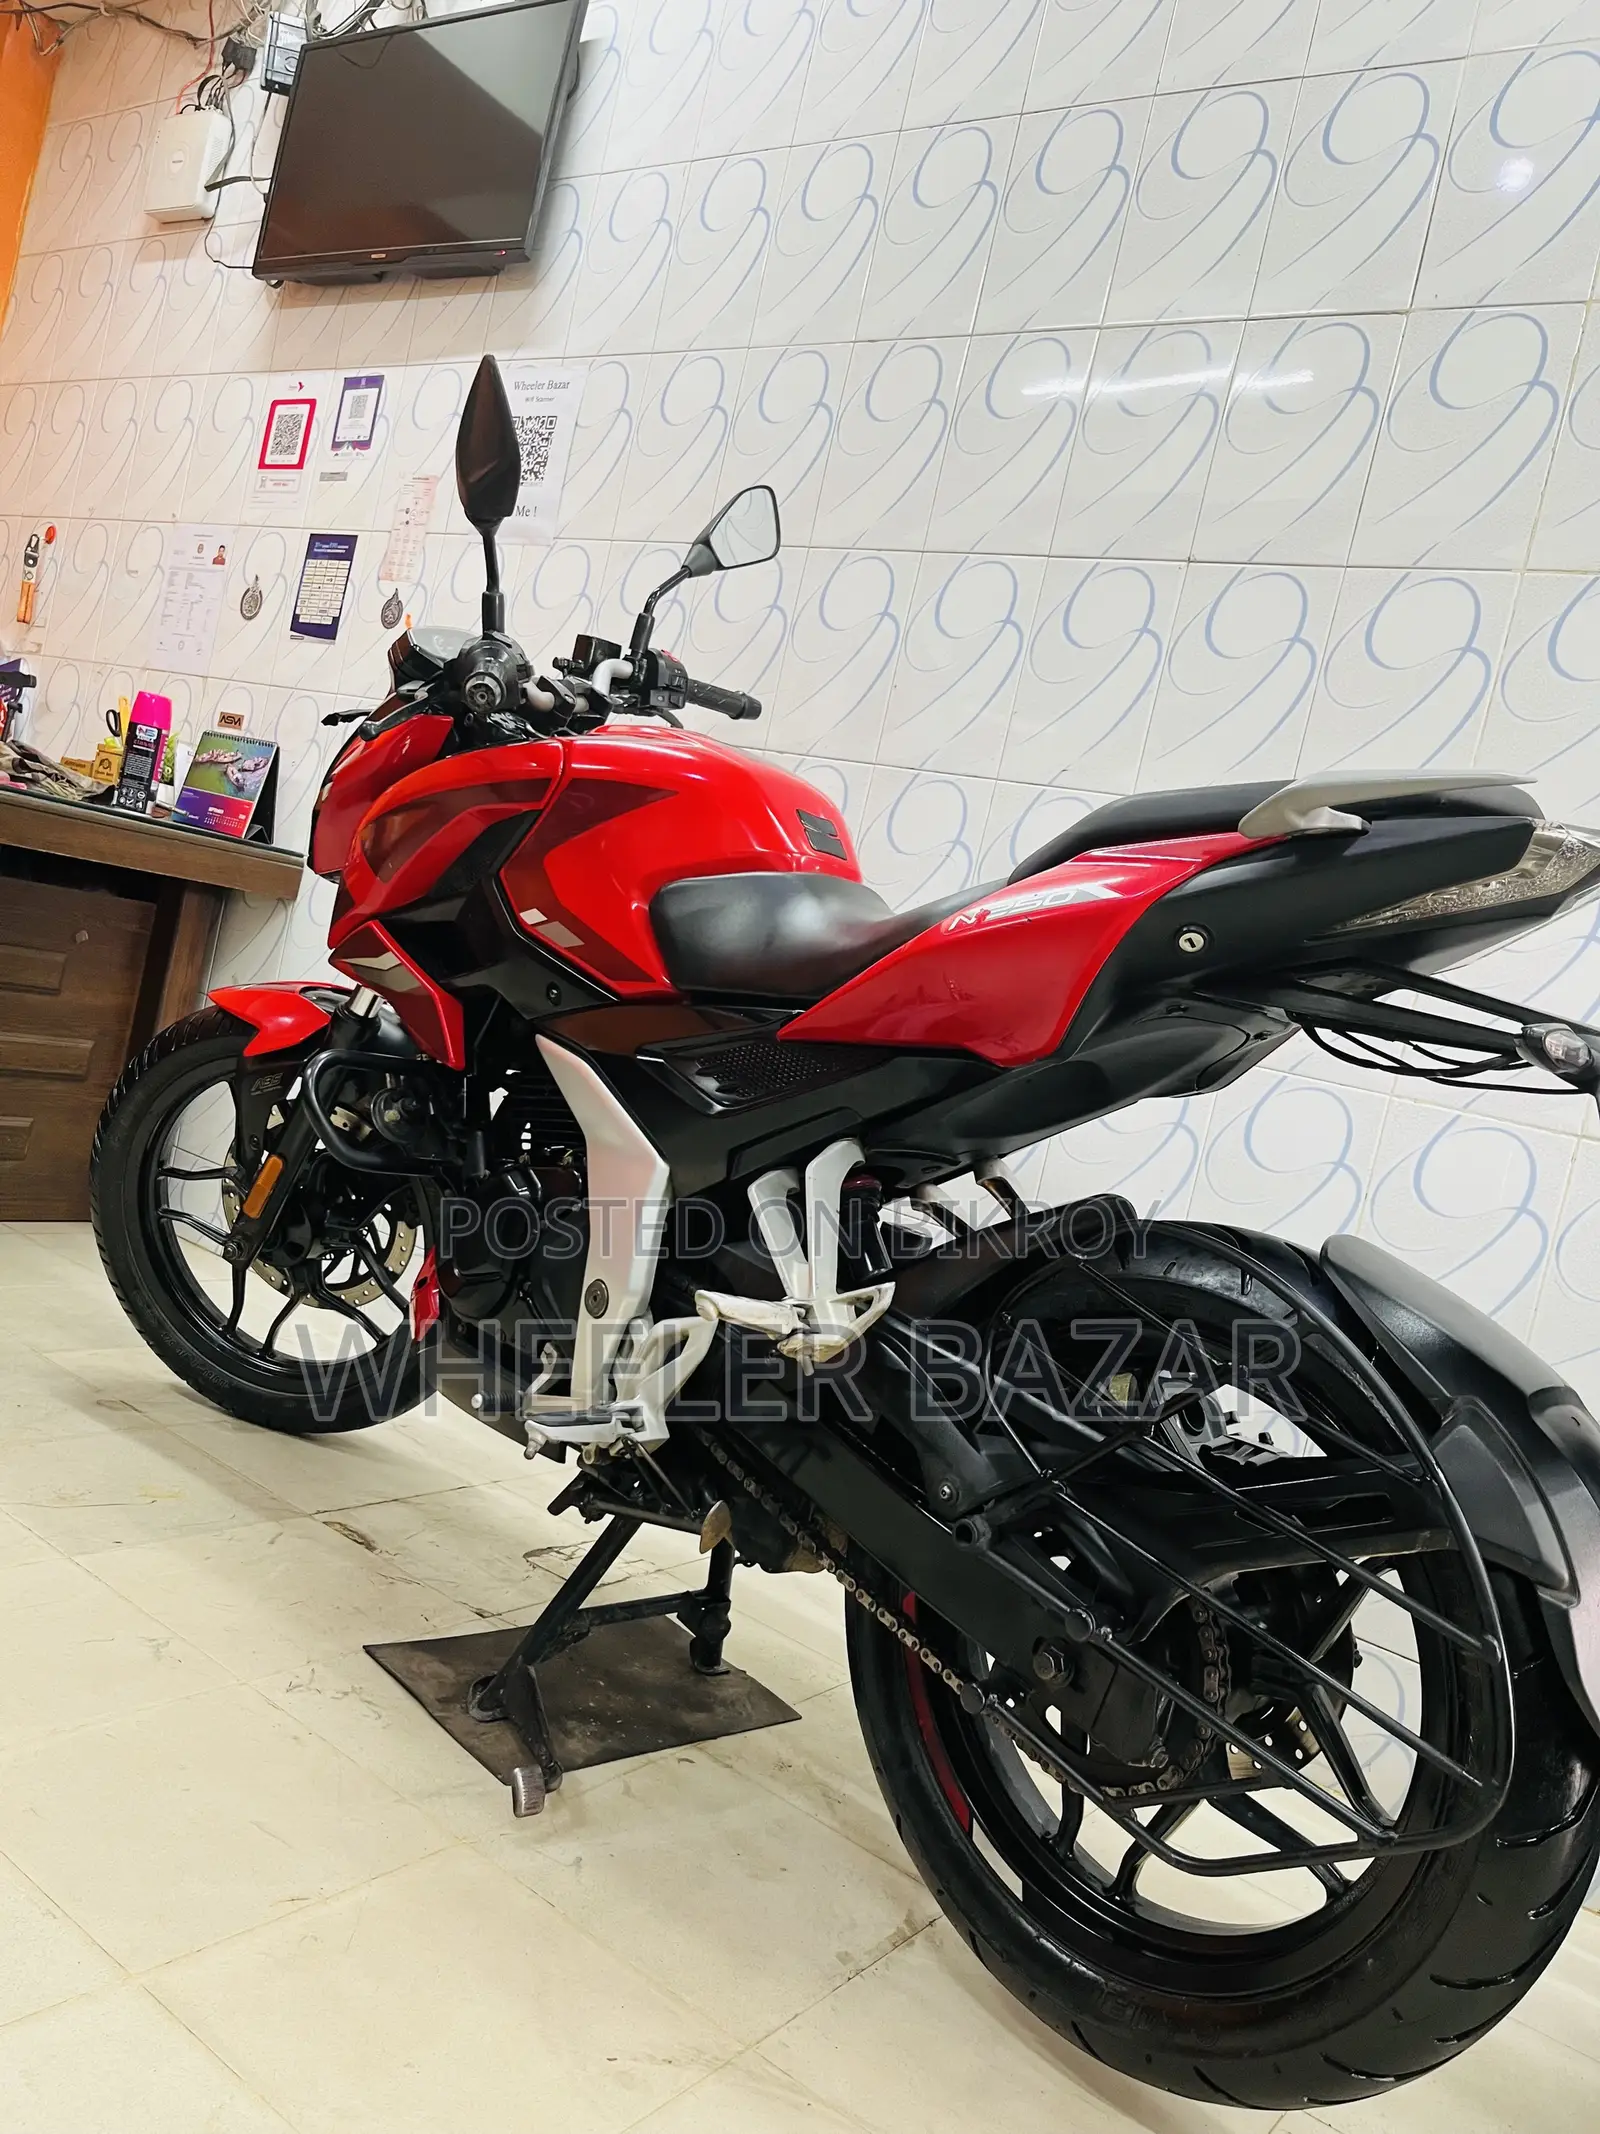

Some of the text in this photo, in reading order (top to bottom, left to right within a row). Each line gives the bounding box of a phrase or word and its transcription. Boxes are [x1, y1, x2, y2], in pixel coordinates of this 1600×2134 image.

[514, 379, 571, 391] Wheeler Bazar
[515, 505, 531, 517] Me
[250, 1072, 284, 1091] ABS
